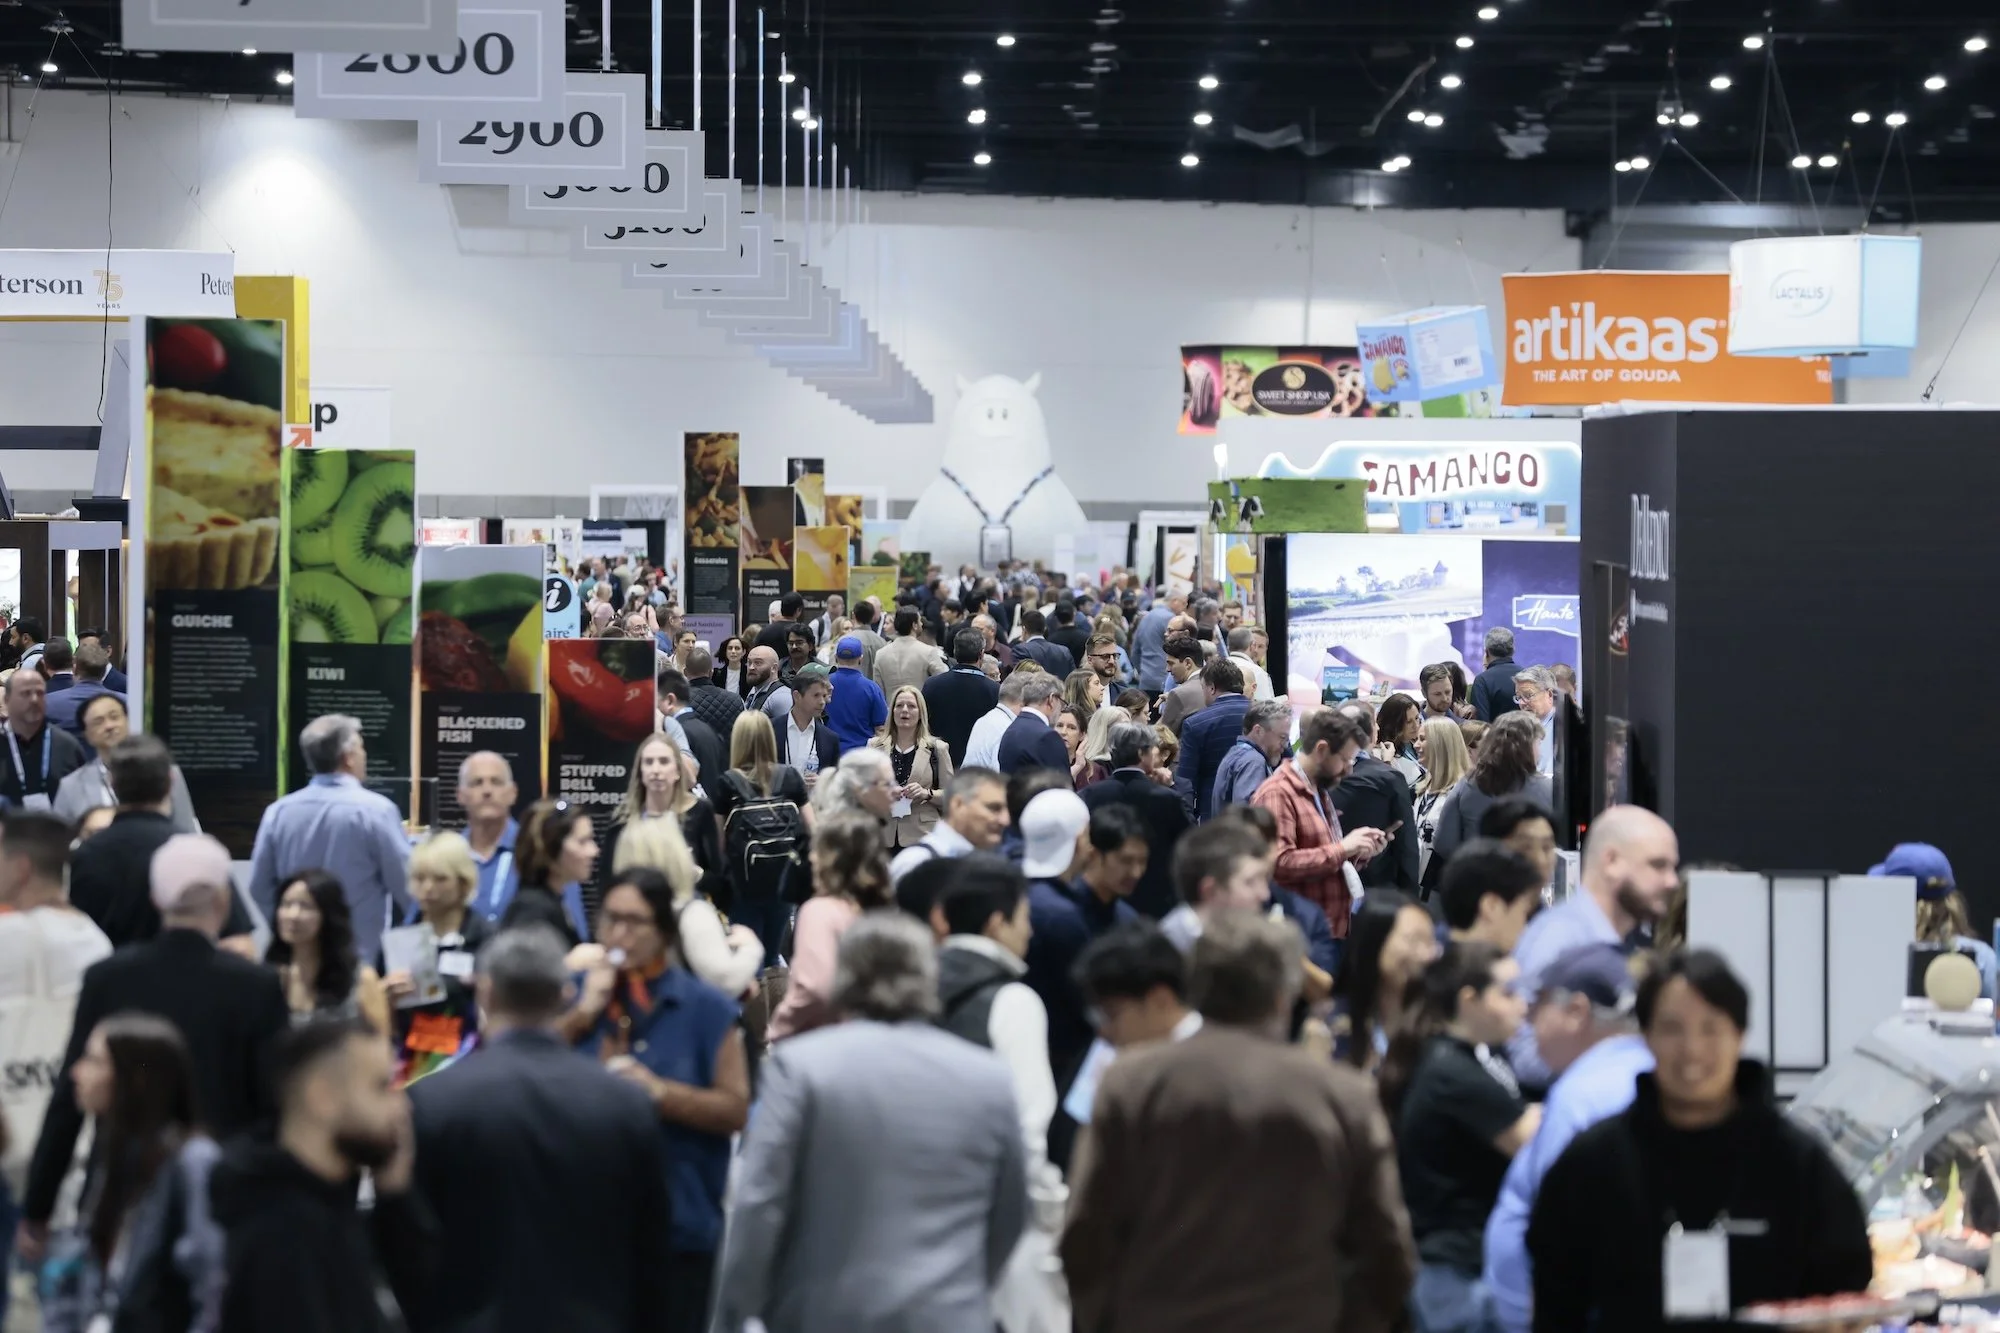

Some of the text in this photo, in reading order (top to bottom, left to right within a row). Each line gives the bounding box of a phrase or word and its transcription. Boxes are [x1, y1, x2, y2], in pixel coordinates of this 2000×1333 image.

[0, 274, 84, 295] terson
[1776, 286, 1825, 299] LACTALIS
[1513, 301, 1719, 363] artikaas
[1532, 369, 1681, 382] THE ART OF GOUDA
[1257, 390, 1331, 400] SWEET SHOP USA
[309, 401, 338, 432] p
[1363, 451, 1539, 496] SAMANCO
[1517, 600, 1576, 626] Haute
[171, 614, 234, 628] QUICHE
[307, 667, 345, 681] KIWI
[437, 716, 527, 730] BLACKENED
[437, 730, 473, 743] FISH
